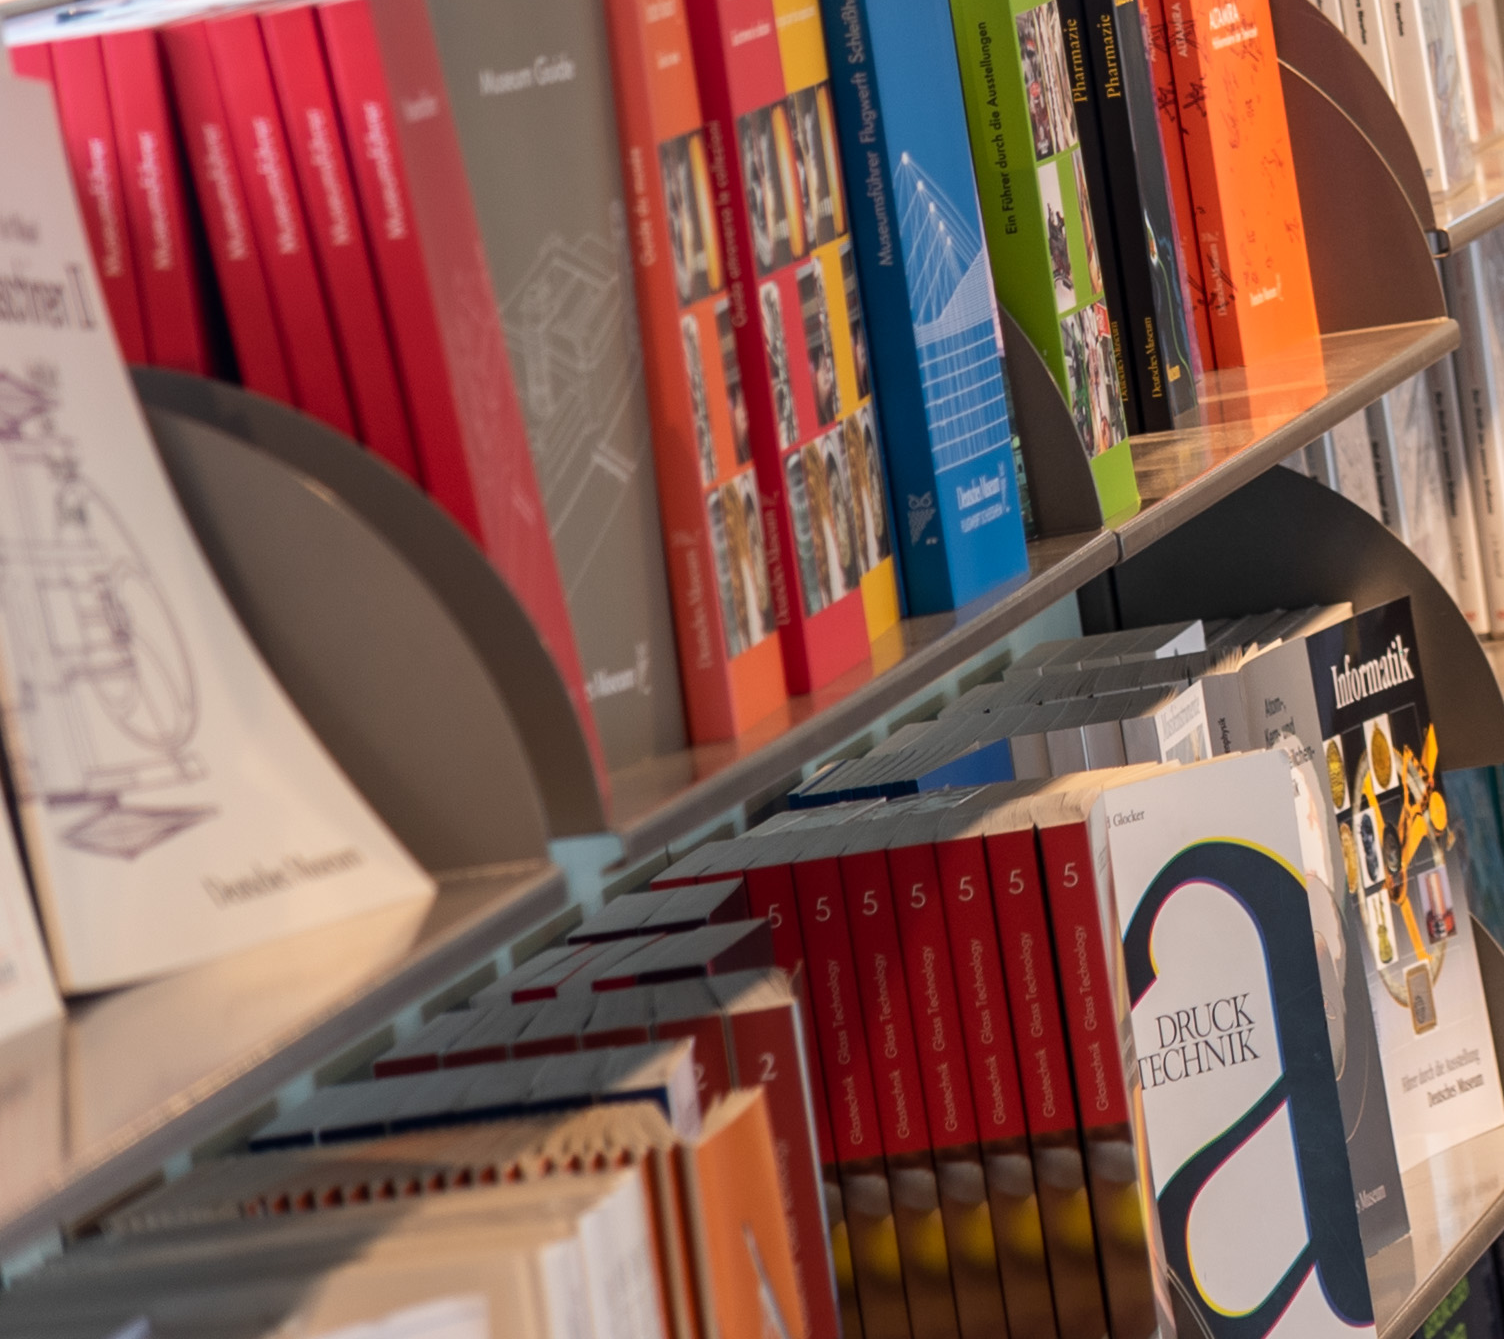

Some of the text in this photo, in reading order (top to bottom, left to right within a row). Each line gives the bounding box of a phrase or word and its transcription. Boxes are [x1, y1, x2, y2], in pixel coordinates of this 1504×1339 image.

[1063, 18, 1088, 103] Pharmazie
[1096, 14, 1121, 99] Pharmazie
[850, 71, 876, 145] Flugwerft
[978, 21, 1018, 235] Ein Führer durch die Ausstellungen
[867, 150, 893, 267] Museumsführer
[1144, 317, 1163, 398] Deutsches Museum
[1330, 634, 1415, 710] Informatik
[1113, 808, 1145, 828] Glocker
[815, 896, 831, 922] 5
[862, 890, 879, 916] 5
[910, 883, 926, 909] 5
[957, 876, 974, 902] 5
[1008, 869, 1025, 895] 5
[1062, 862, 1079, 888] 5
[827, 959, 863, 1145] Glastechnik Glass Technology
[874, 953, 910, 1139] Glastechnik Glass Technology
[922, 946, 958, 1132] Glastechnik Glass Technology
[969, 938, 1007, 1125] Glastechnik Glass Technology
[1019, 932, 1056, 1118] Glastechnik Glass Technology
[1074, 925, 1110, 1111] Glastechnik Glass Technology
[1155, 992, 1256, 1050] DRUCK
[759, 1052, 778, 1082] 2
[1137, 1026, 1261, 1091] TECHNIK
